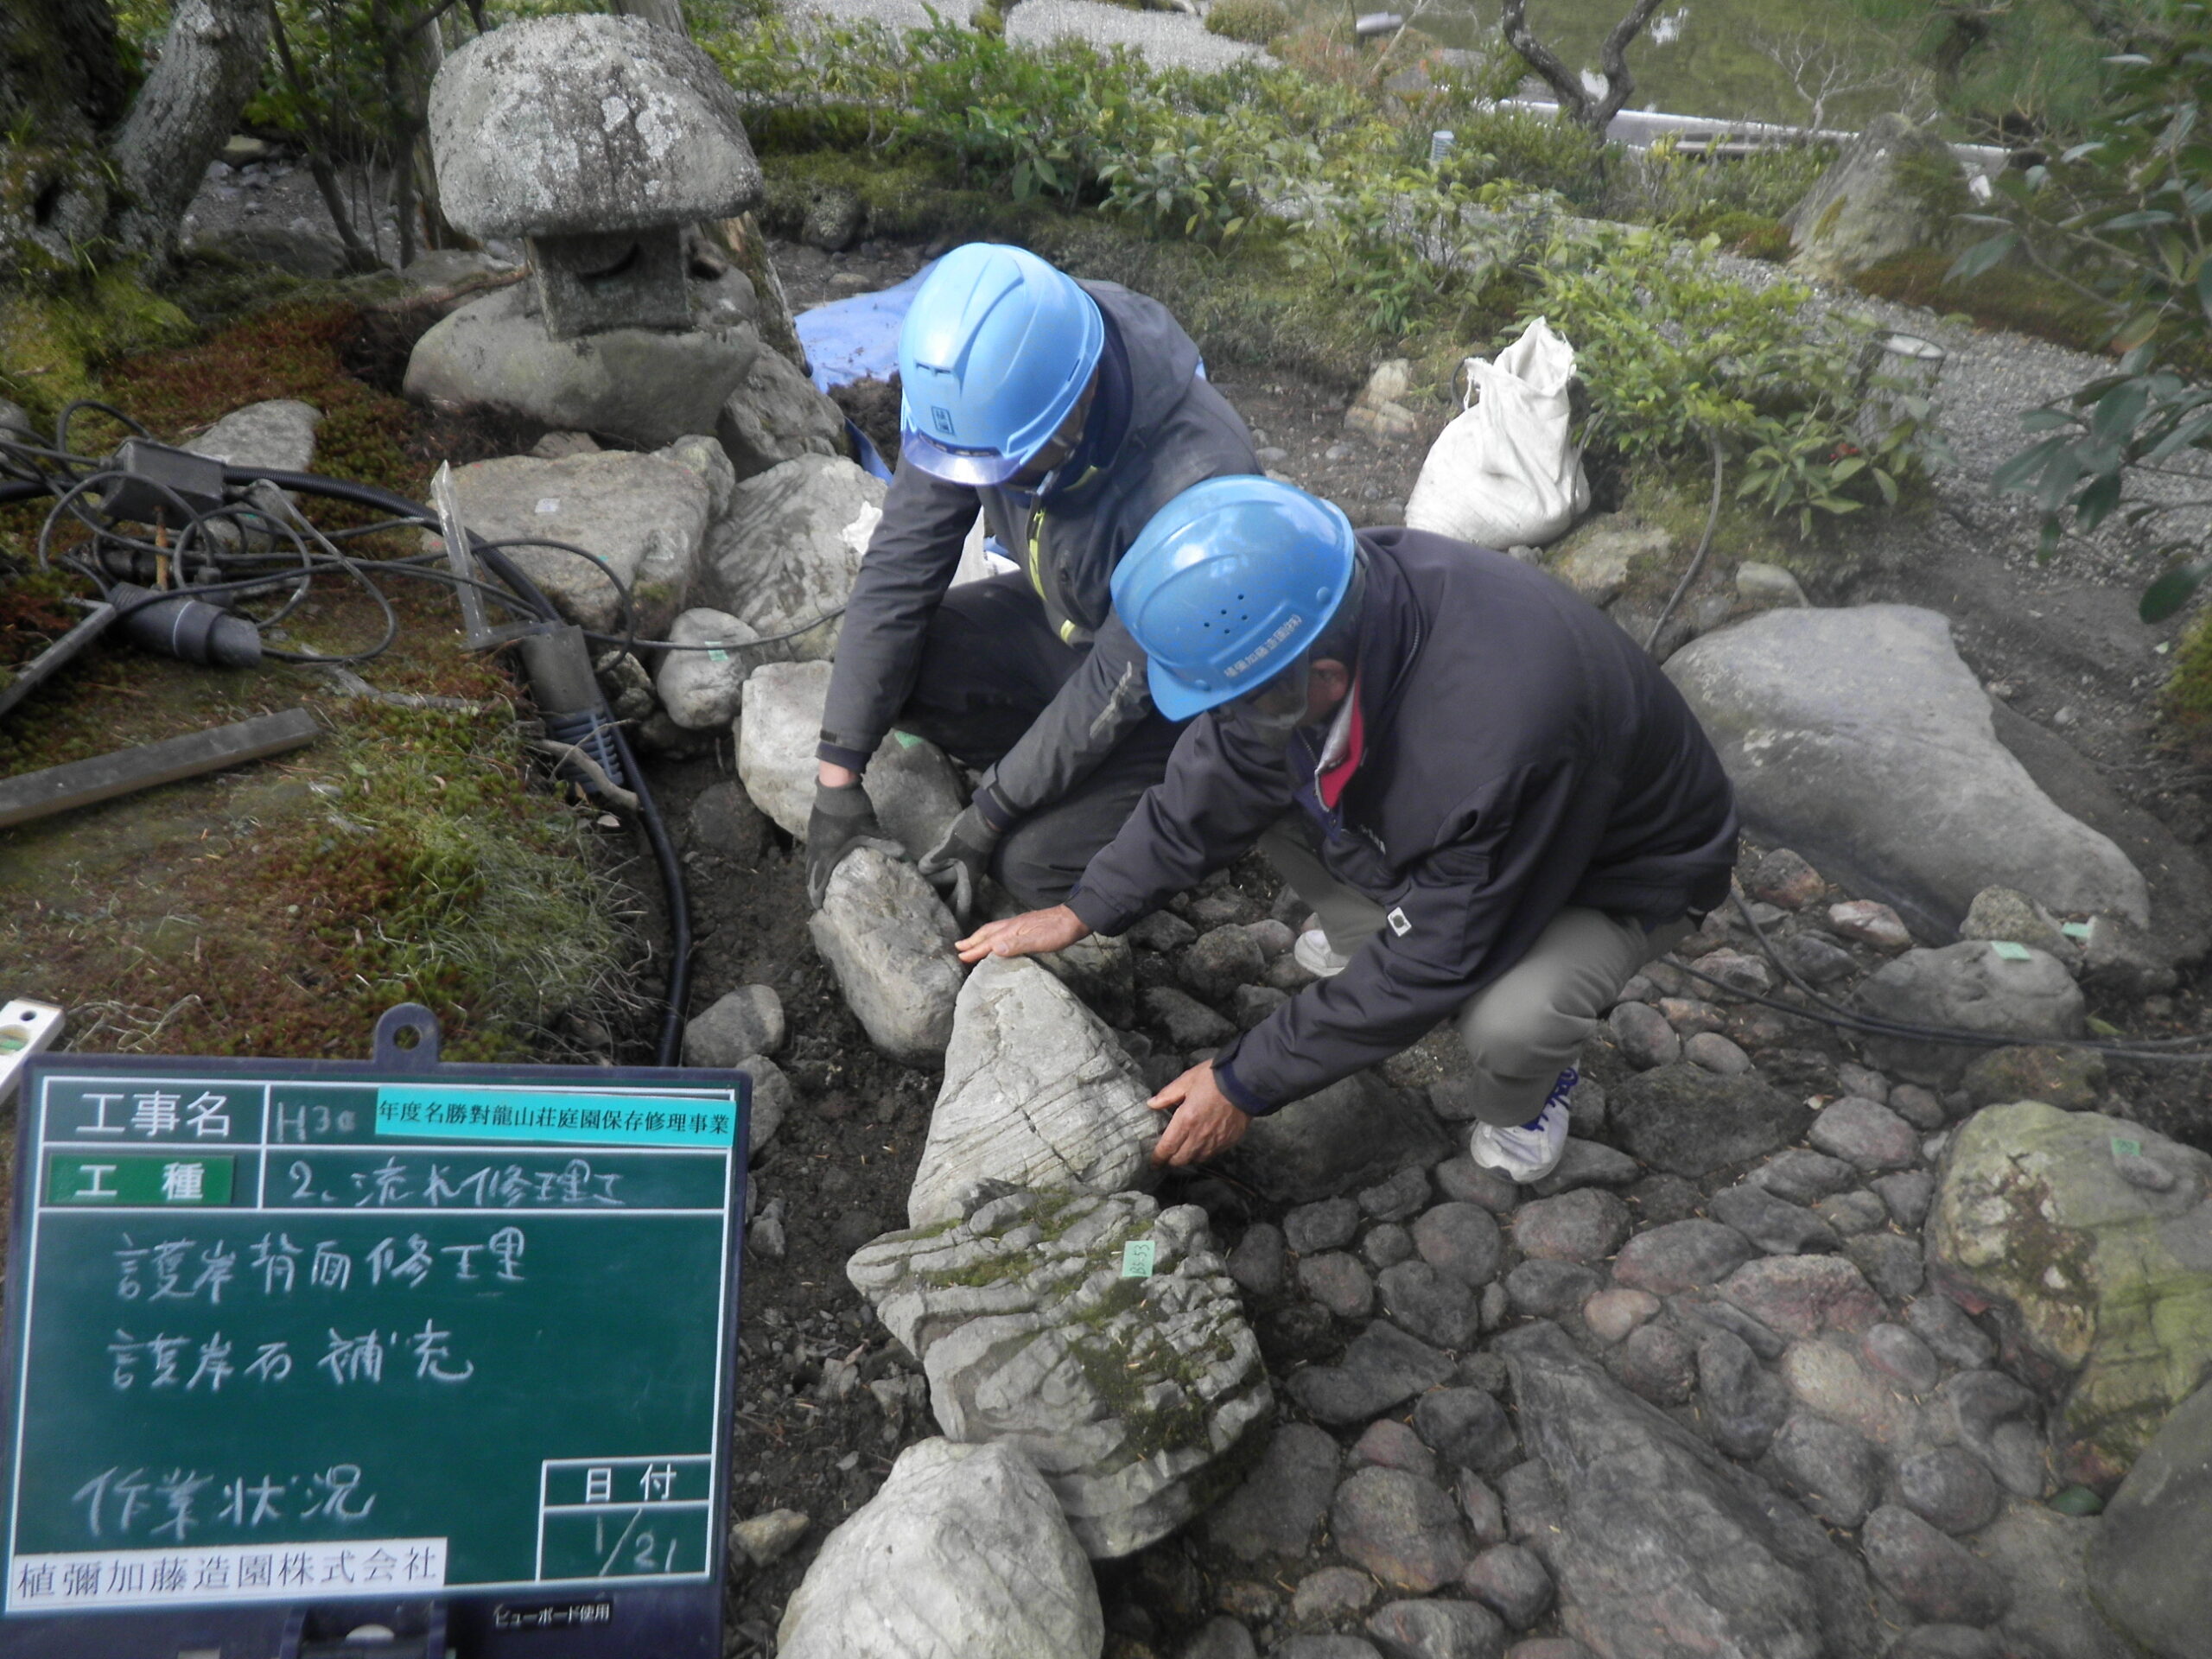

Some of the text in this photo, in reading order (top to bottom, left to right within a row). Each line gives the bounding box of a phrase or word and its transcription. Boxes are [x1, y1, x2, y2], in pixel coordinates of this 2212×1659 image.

[75, 1090, 231, 1137] 工事名
[72, 1464, 375, 1540] 作業状況
[17, 1547, 437, 1599] 植彌加藤造園株式会社
